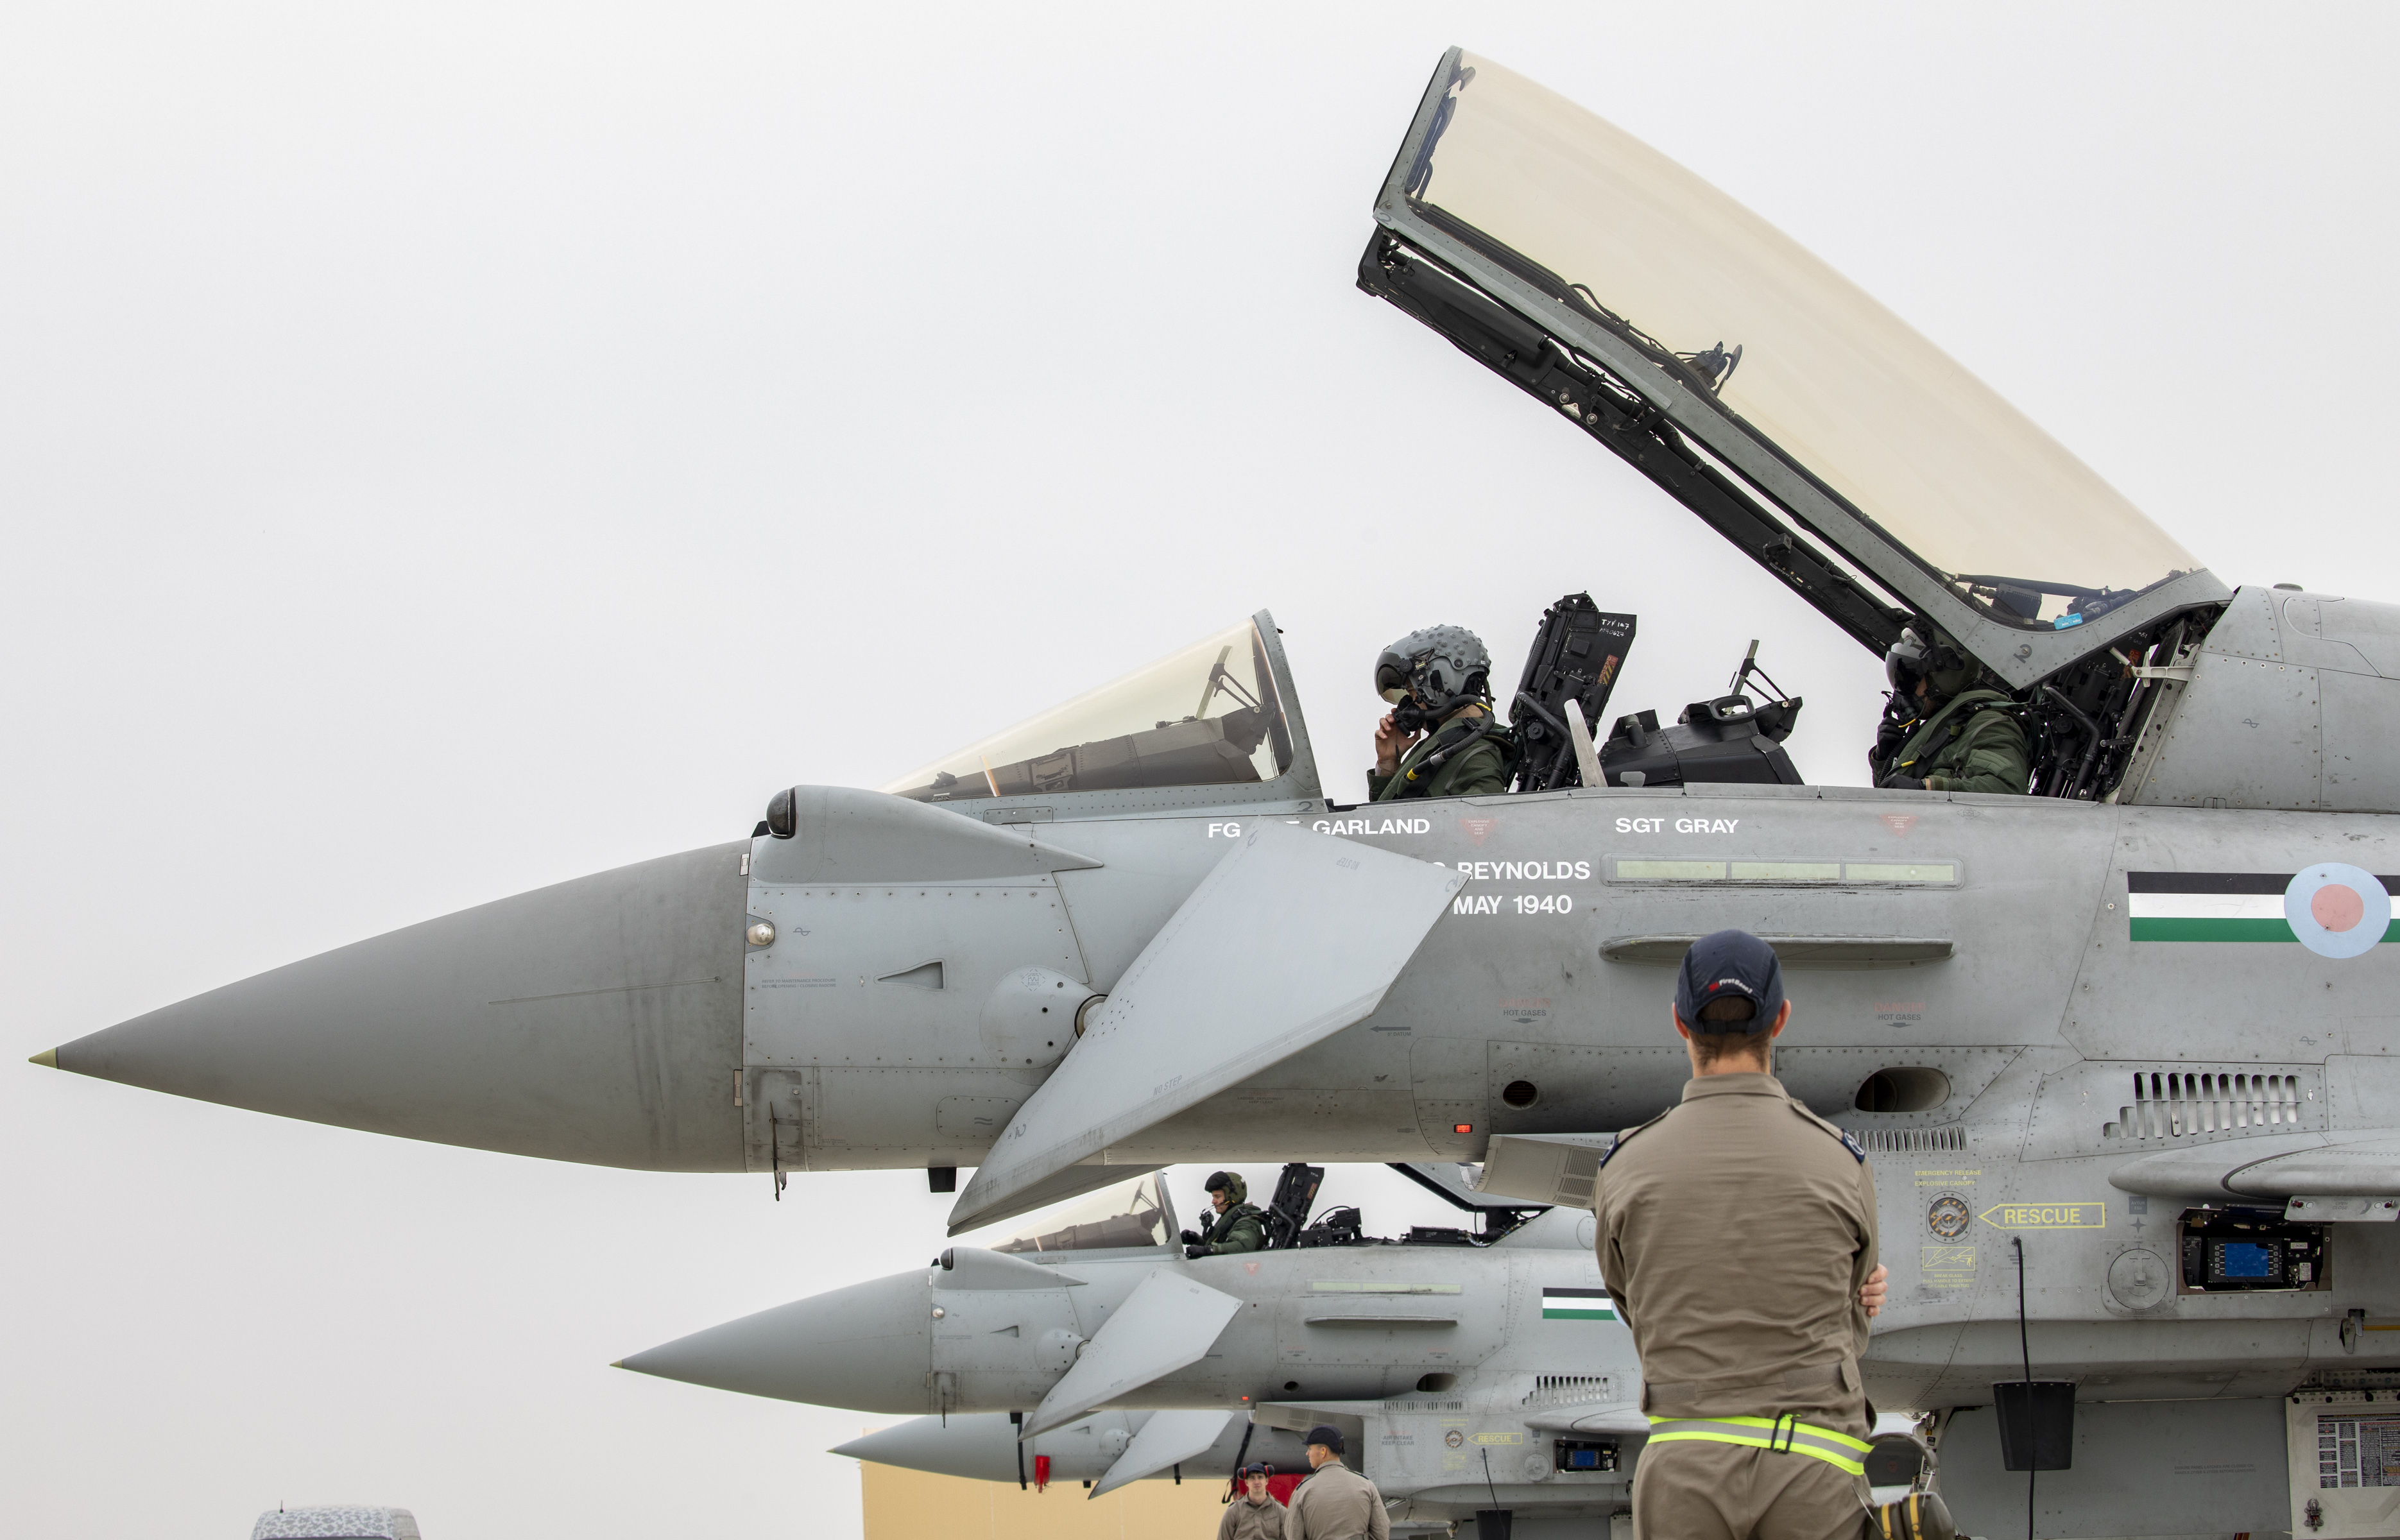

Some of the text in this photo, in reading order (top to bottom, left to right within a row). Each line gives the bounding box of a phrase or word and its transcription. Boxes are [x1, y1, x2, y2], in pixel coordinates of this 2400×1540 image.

[1597, 656, 1611, 684] DANGER
[1297, 801, 1314, 812] 2
[1208, 823, 1240, 838] FG
[1312, 819, 1430, 835] GARLAND
[1615, 818, 1739, 834] SGT GRAY
[1336, 857, 1360, 871] NO STEP
[1457, 861, 1591, 880] REYNOLDS
[1453, 895, 1572, 914] MAY 1940
[1499, 998, 1551, 1008] DANGER
[1874, 1002, 1926, 1012] DANGER
[1153, 1075, 1182, 1096] NO STEP
[2004, 1208, 2080, 1224] RESCUE
